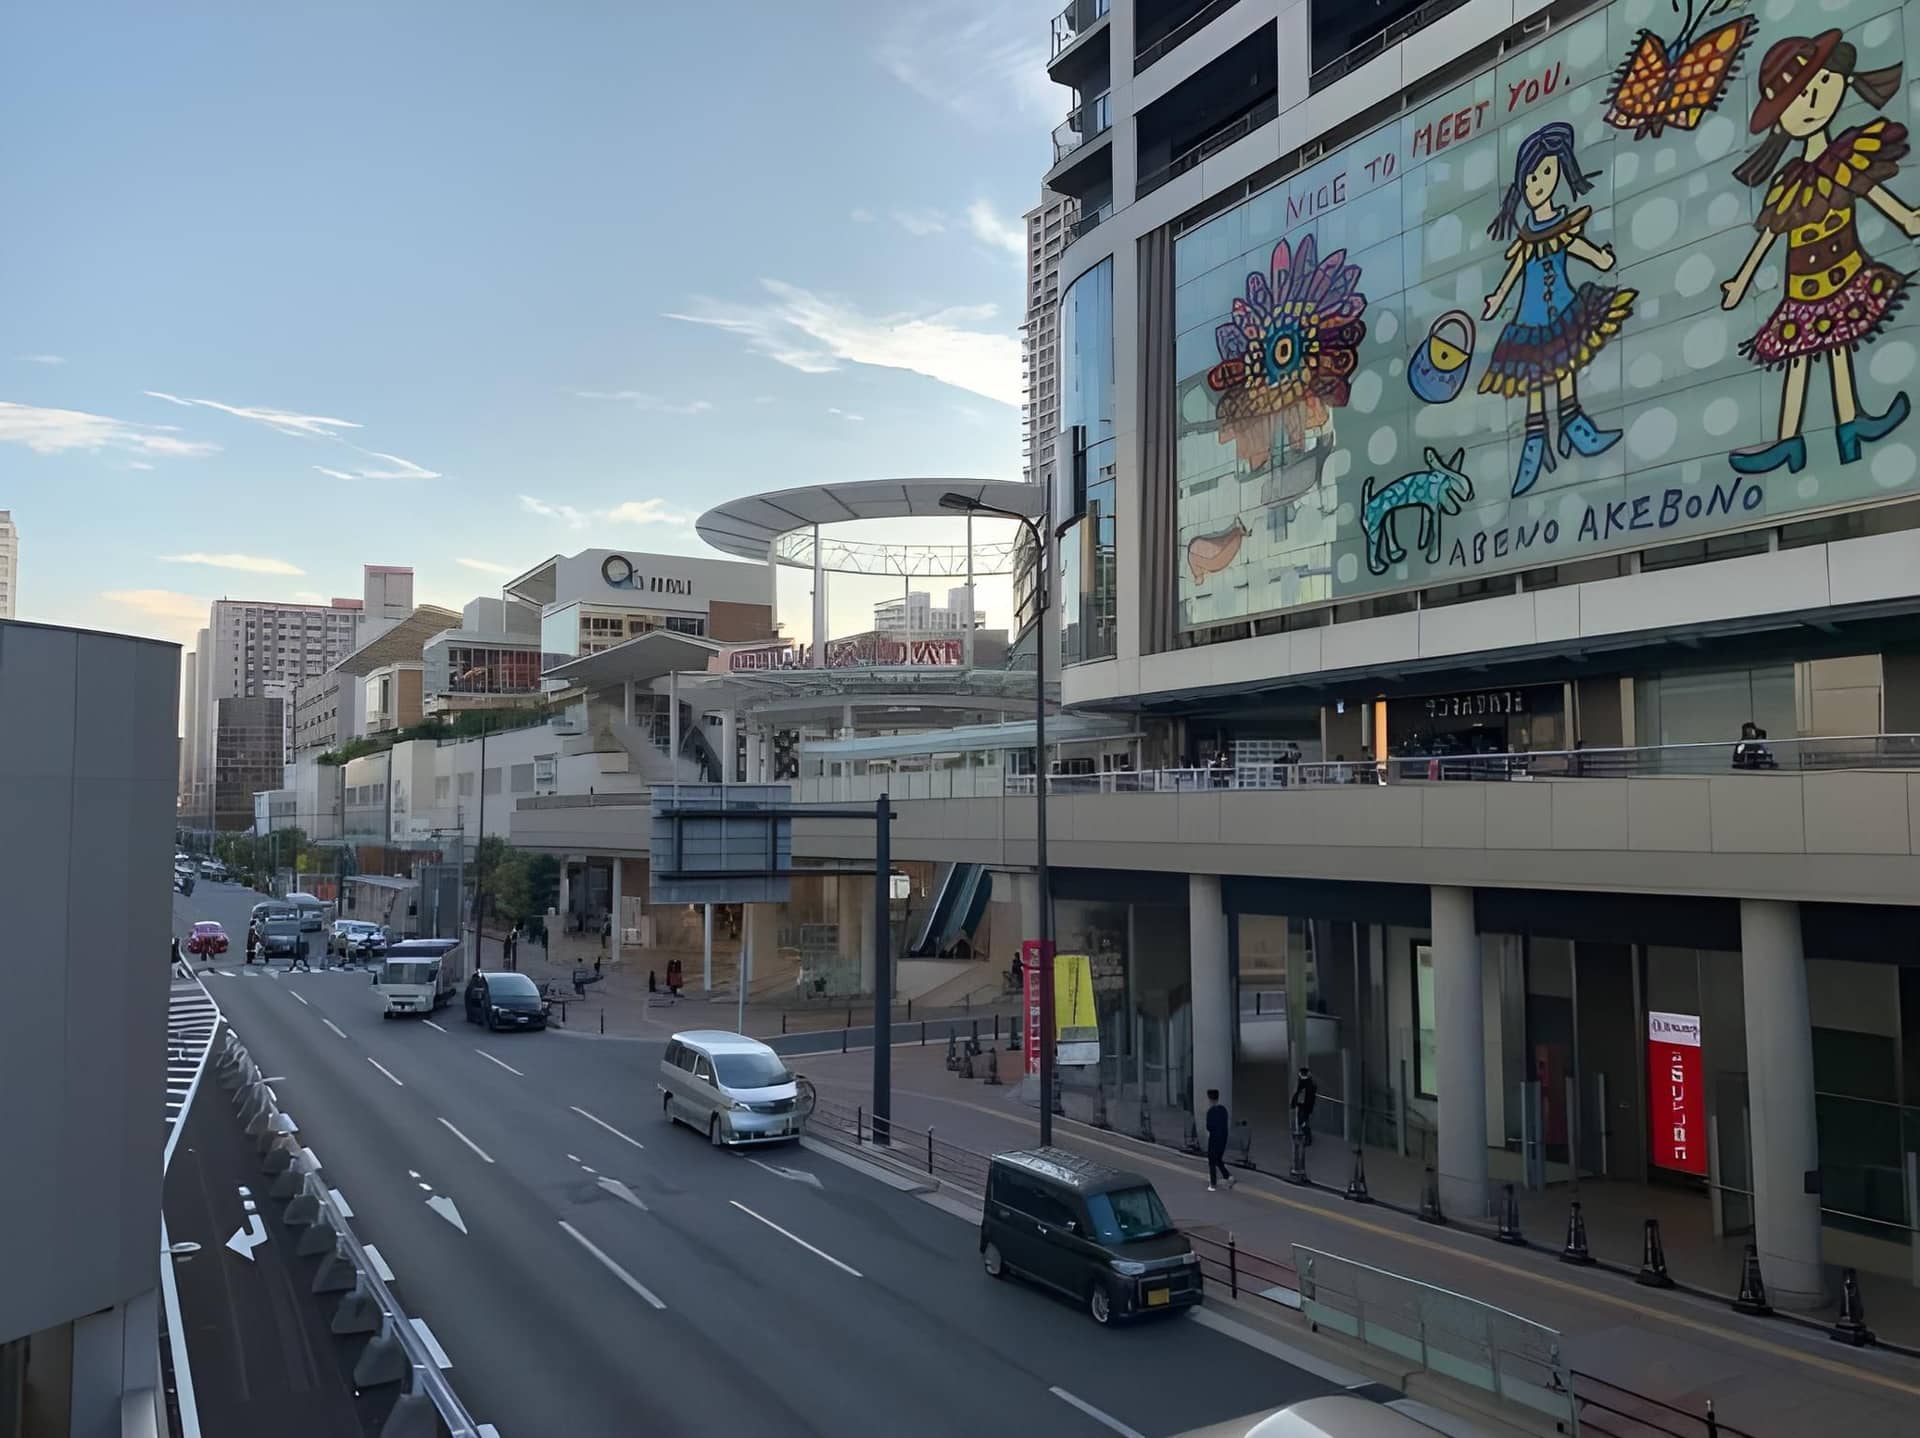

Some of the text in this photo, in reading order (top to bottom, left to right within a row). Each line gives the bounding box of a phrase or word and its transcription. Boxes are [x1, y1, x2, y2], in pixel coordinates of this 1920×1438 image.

[1363, 151, 1396, 183] TO
[1411, 100, 1490, 159] MEET
[1449, 475, 1764, 567] ABENO AKEBONO
